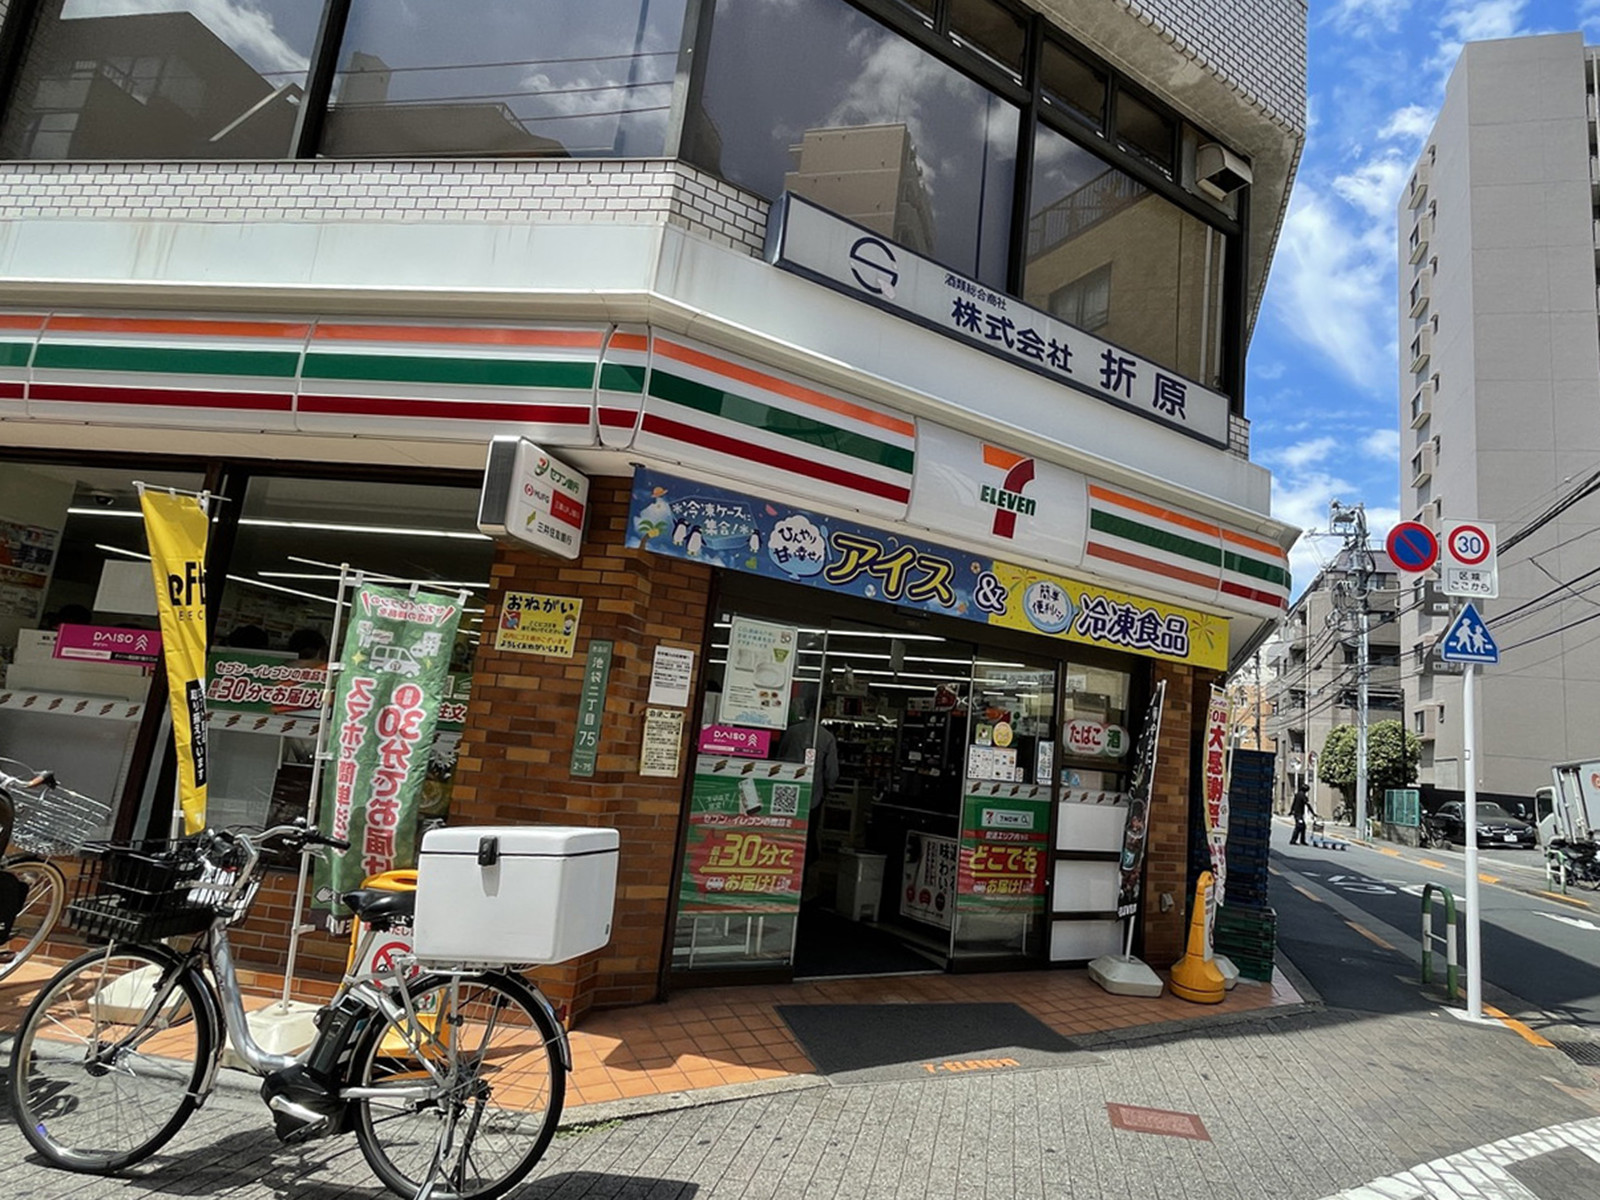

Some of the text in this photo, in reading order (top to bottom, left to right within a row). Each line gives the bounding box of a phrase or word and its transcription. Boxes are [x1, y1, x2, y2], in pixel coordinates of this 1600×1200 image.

[951, 296, 1187, 420] 株式会社 折原
[682, 500, 752, 522] 冷凍ケースに
[777, 526, 817, 544] ひんやり
[1457, 535, 1482, 554] 30
[825, 531, 1007, 615] アイス &
[1459, 572, 1481, 580] 区域
[1450, 582, 1490, 592] ここから
[507, 595, 574, 613] おねがい
[1076, 594, 1190, 657] 冷凍食品
[93, 631, 134, 643] DAISO
[579, 731, 596, 747] 75
[714, 730, 746, 741] DAISO
[1069, 724, 1122, 748] たばこ 酒
[969, 846, 1037, 873] どこでも
